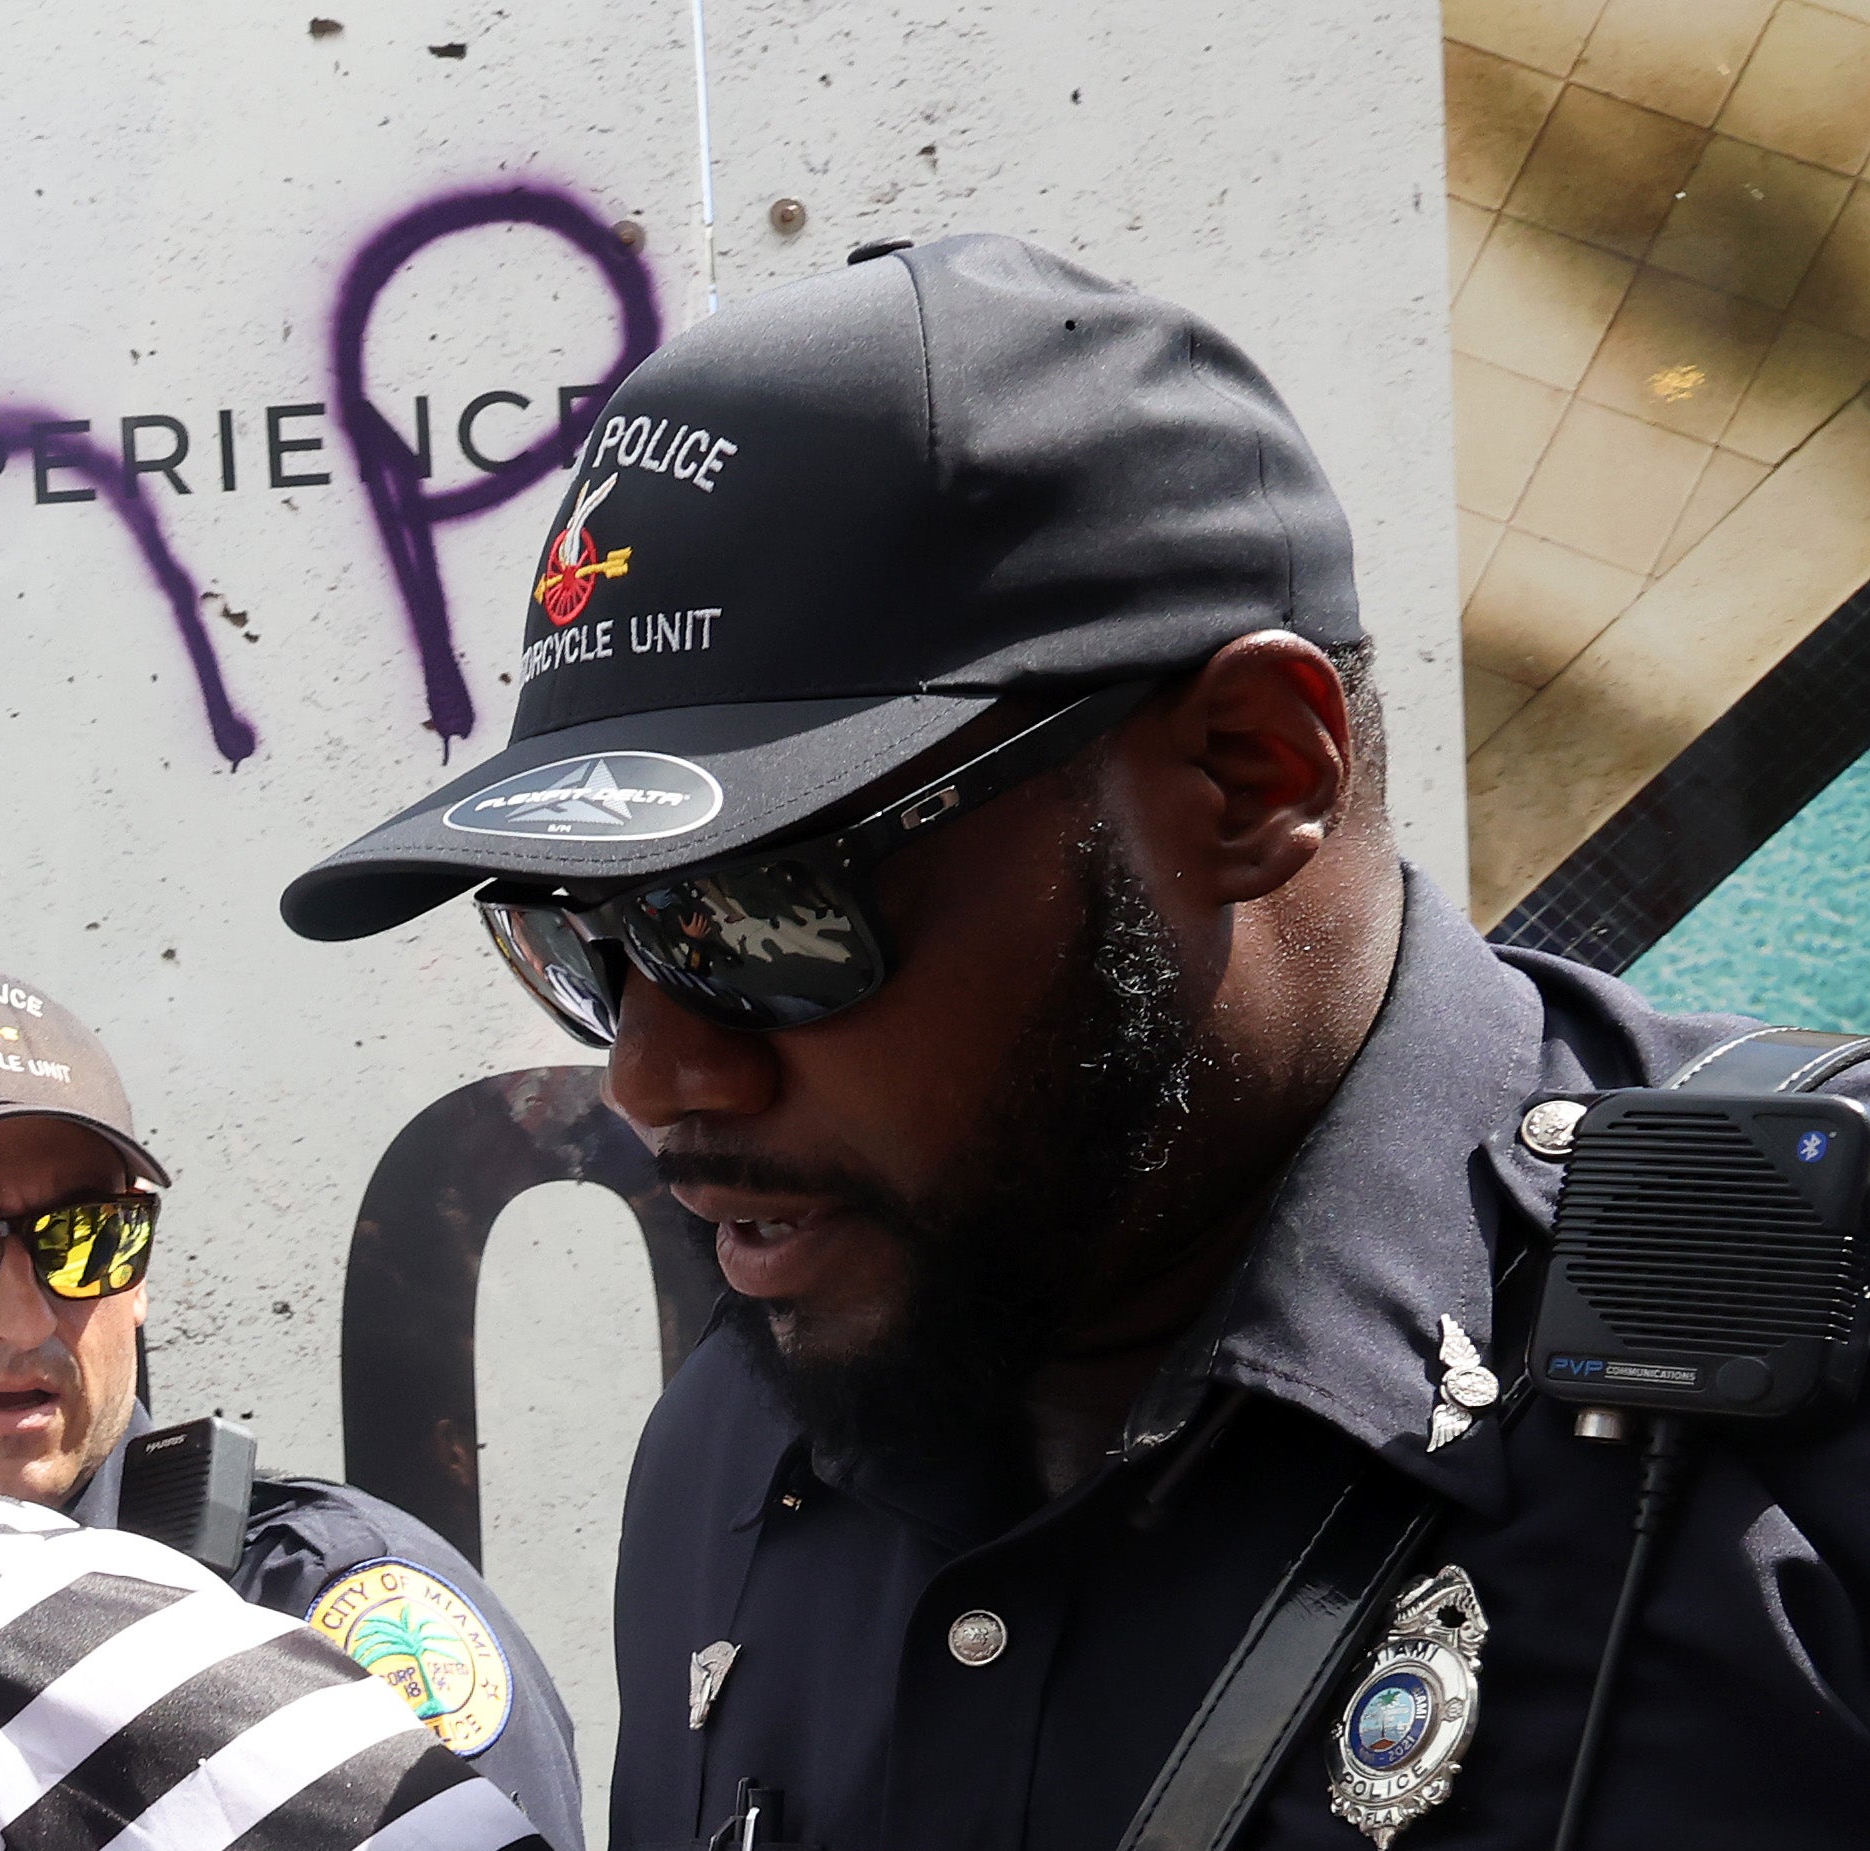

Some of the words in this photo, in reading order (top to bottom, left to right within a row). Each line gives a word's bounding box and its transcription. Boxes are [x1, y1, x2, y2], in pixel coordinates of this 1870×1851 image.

[592, 415, 739, 493] POLICE
[630, 608, 723, 654] UNIT
[27, 1058, 73, 1085] UNIT
[1547, 1357, 1605, 1377] PVP
[1605, 1365, 1697, 1383] COMMUNICATIONS
[321, 1581, 370, 1631] CITY
[423, 1585, 492, 1659] MIAMI
[1340, 1760, 1428, 1798] POLICE
